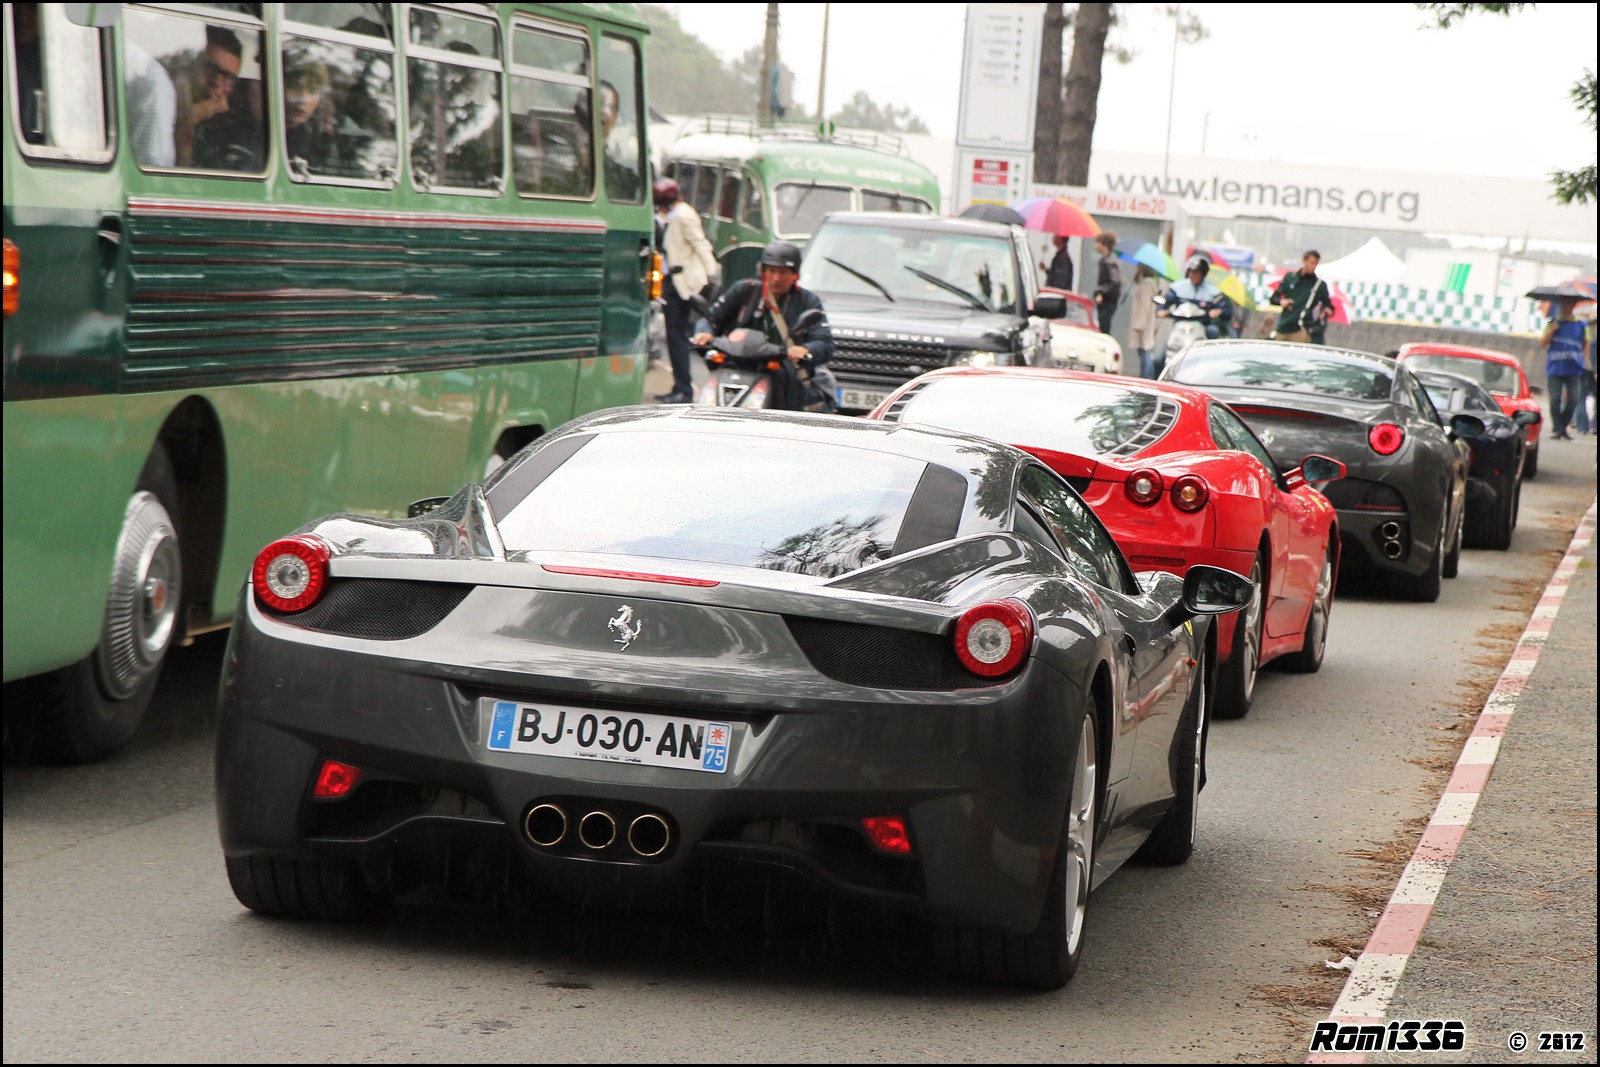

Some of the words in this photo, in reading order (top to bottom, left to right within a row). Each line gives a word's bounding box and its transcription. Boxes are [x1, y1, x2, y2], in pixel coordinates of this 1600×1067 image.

[1096, 193, 1126, 211] Maxi
[1129, 198, 1166, 216] 4m20
[1106, 173, 1420, 222] www.lemans.org
[831, 328, 876, 338] ANGE
[887, 333, 944, 343] ROVER
[496, 730, 506, 741] F
[705, 748, 725, 767] 75
